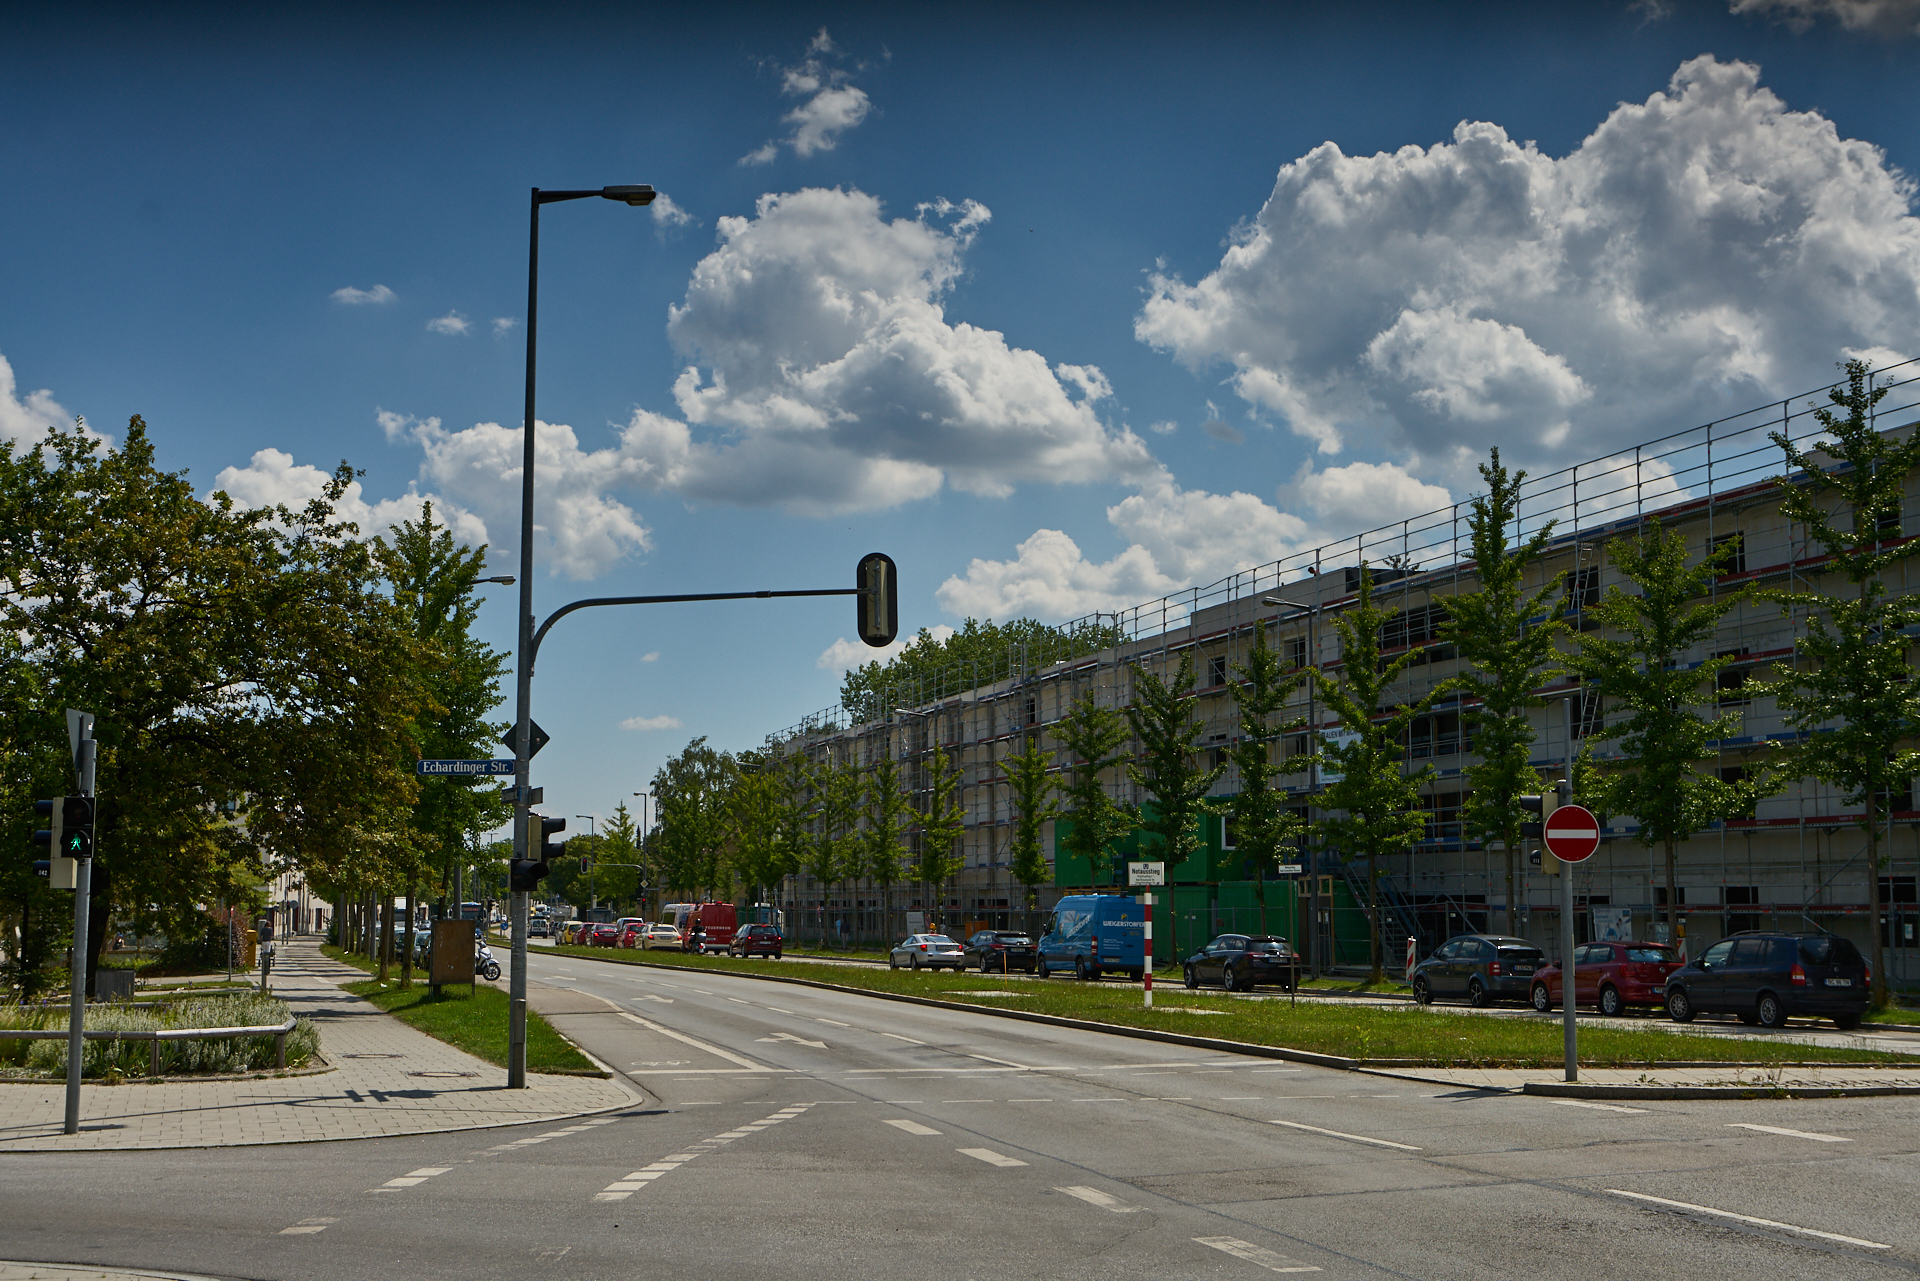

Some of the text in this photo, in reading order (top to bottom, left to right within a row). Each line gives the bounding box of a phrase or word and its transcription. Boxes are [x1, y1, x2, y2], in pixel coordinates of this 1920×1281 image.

[422, 761, 509, 774] Echardinger Str.
[1131, 868, 1160, 876] Notausstieg
